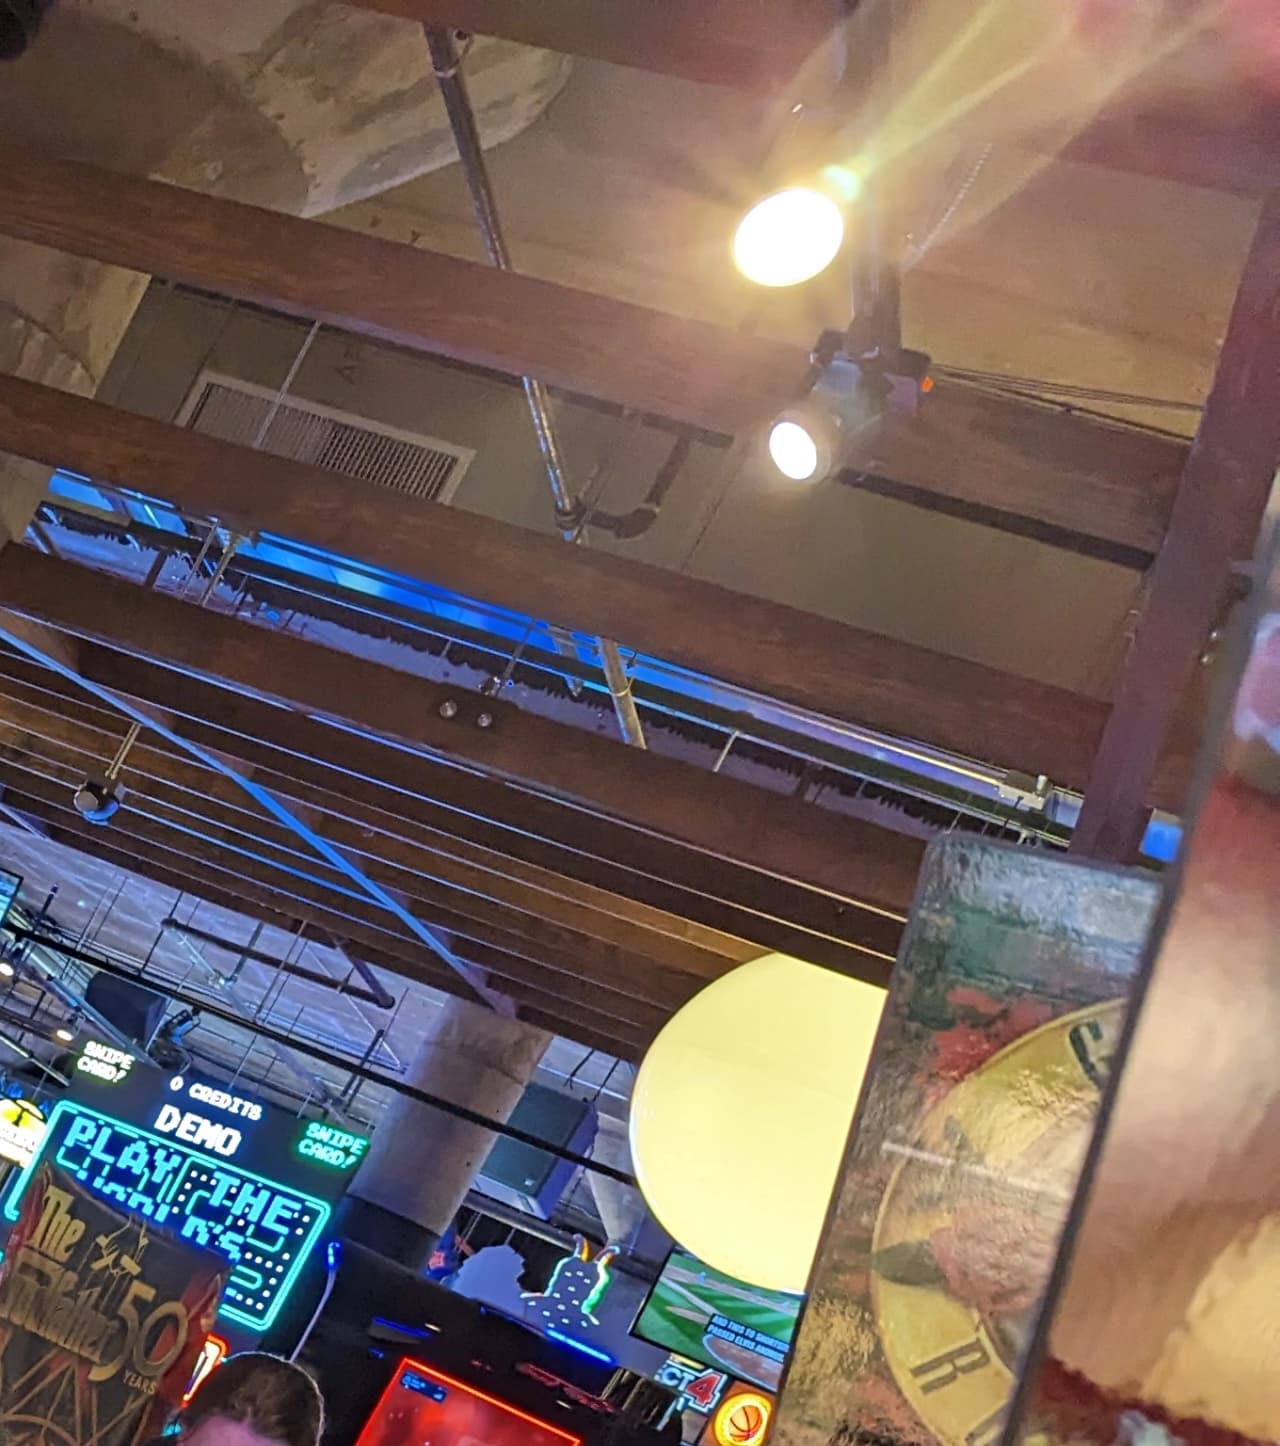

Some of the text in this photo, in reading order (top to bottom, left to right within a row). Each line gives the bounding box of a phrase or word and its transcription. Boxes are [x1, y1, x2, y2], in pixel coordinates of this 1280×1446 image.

[77, 1057, 127, 1083] CARD!
[83, 1040, 135, 1070] SWIPE
[188, 1082, 263, 1121] CREDITS
[153, 1103, 242, 1157] DEMO
[305, 1122, 369, 1155] SWIPE
[298, 1138, 357, 1168] CARD!
[63, 1115, 182, 1184] PLAY
[208, 1170, 302, 1235] THE
[123, 1368, 159, 1394] YEARS
[687, 1373, 722, 1408] 4
